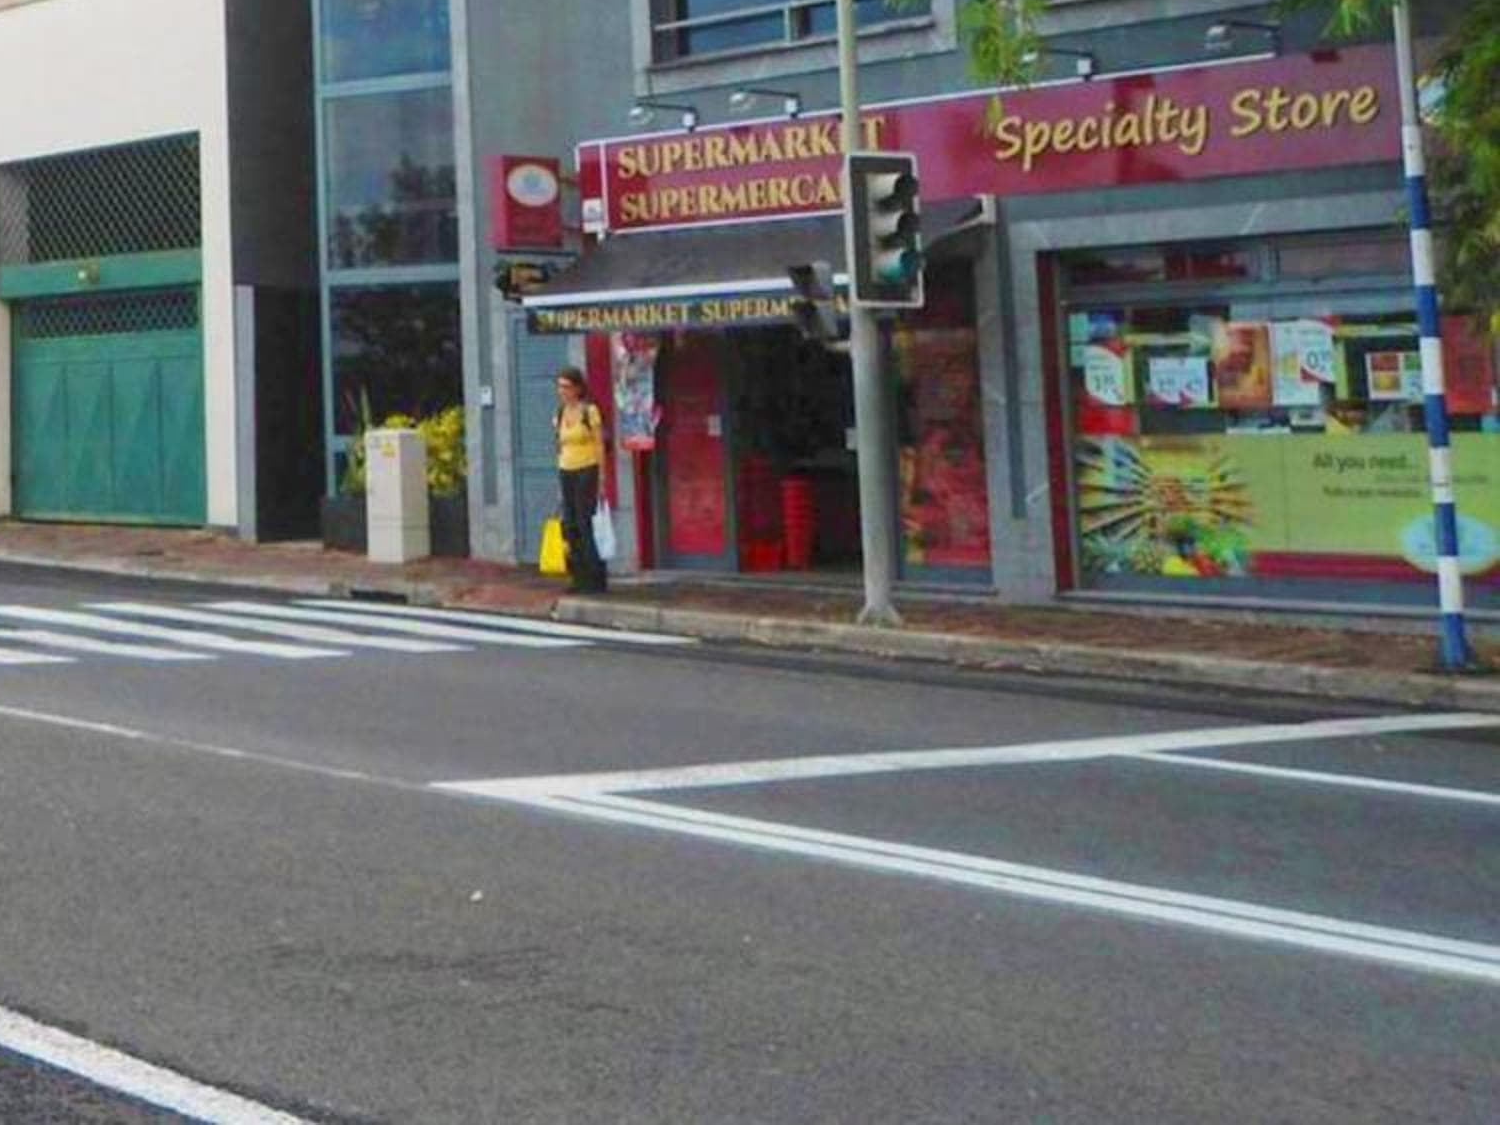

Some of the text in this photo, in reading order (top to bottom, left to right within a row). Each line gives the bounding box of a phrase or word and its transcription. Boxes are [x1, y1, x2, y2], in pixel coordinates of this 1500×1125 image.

[617, 116, 886, 179] SUPERMARKT
[995, 84, 1378, 172] Specialty Store
[619, 173, 844, 222] SUPERMERCA
[536, 303, 689, 332] SUPERMARKET
